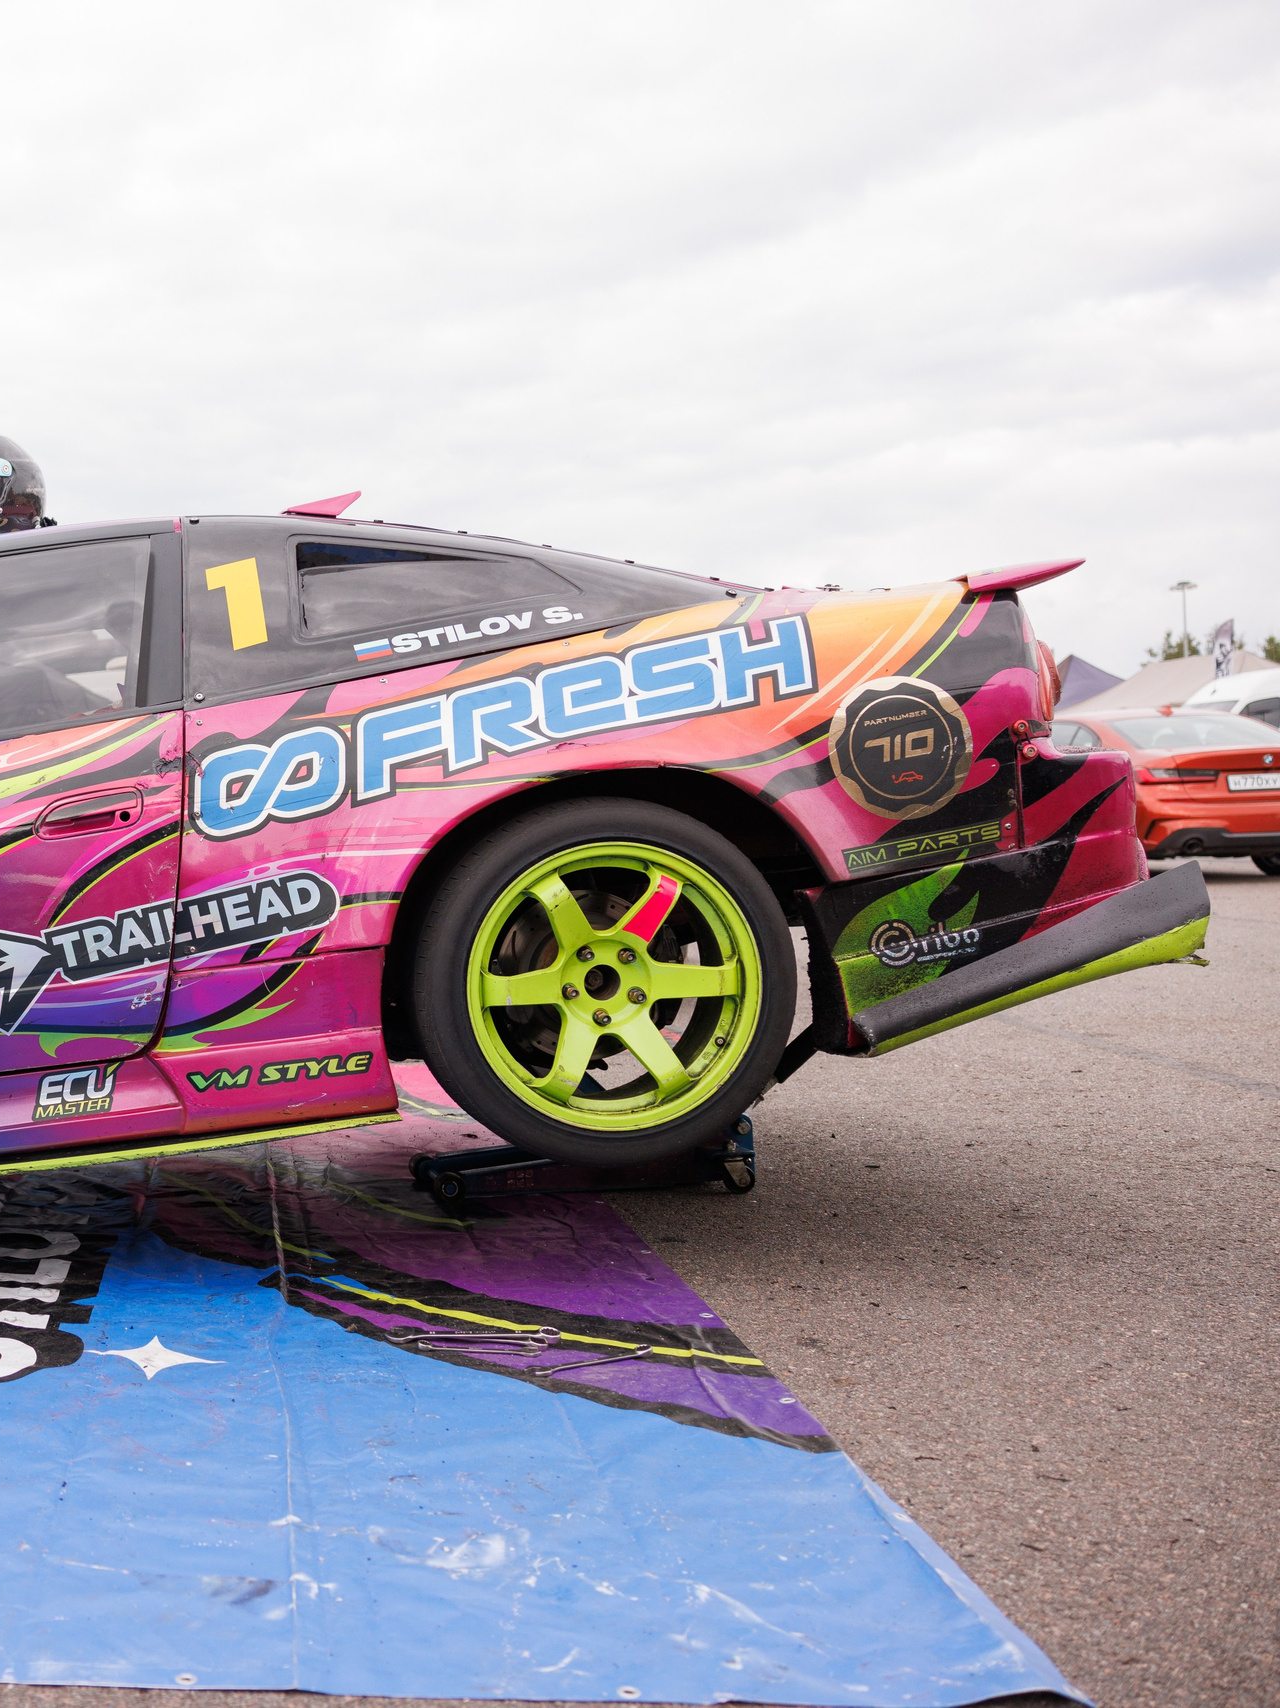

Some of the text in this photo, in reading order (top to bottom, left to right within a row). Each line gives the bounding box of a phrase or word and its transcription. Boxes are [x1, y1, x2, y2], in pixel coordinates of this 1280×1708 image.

[205, 557, 268, 651] 1
[390, 606, 584, 653] STILOV S.
[863, 709, 927, 727] PARTNUMBER
[864, 728, 935, 763] 710
[848, 825, 1000, 868] AIM PARTS
[51, 879, 321, 968] TRAILHEAD
[39, 1061, 121, 1106] ECU
[190, 1054, 370, 1090] VM STYLE
[35, 1097, 111, 1119] MASTER
